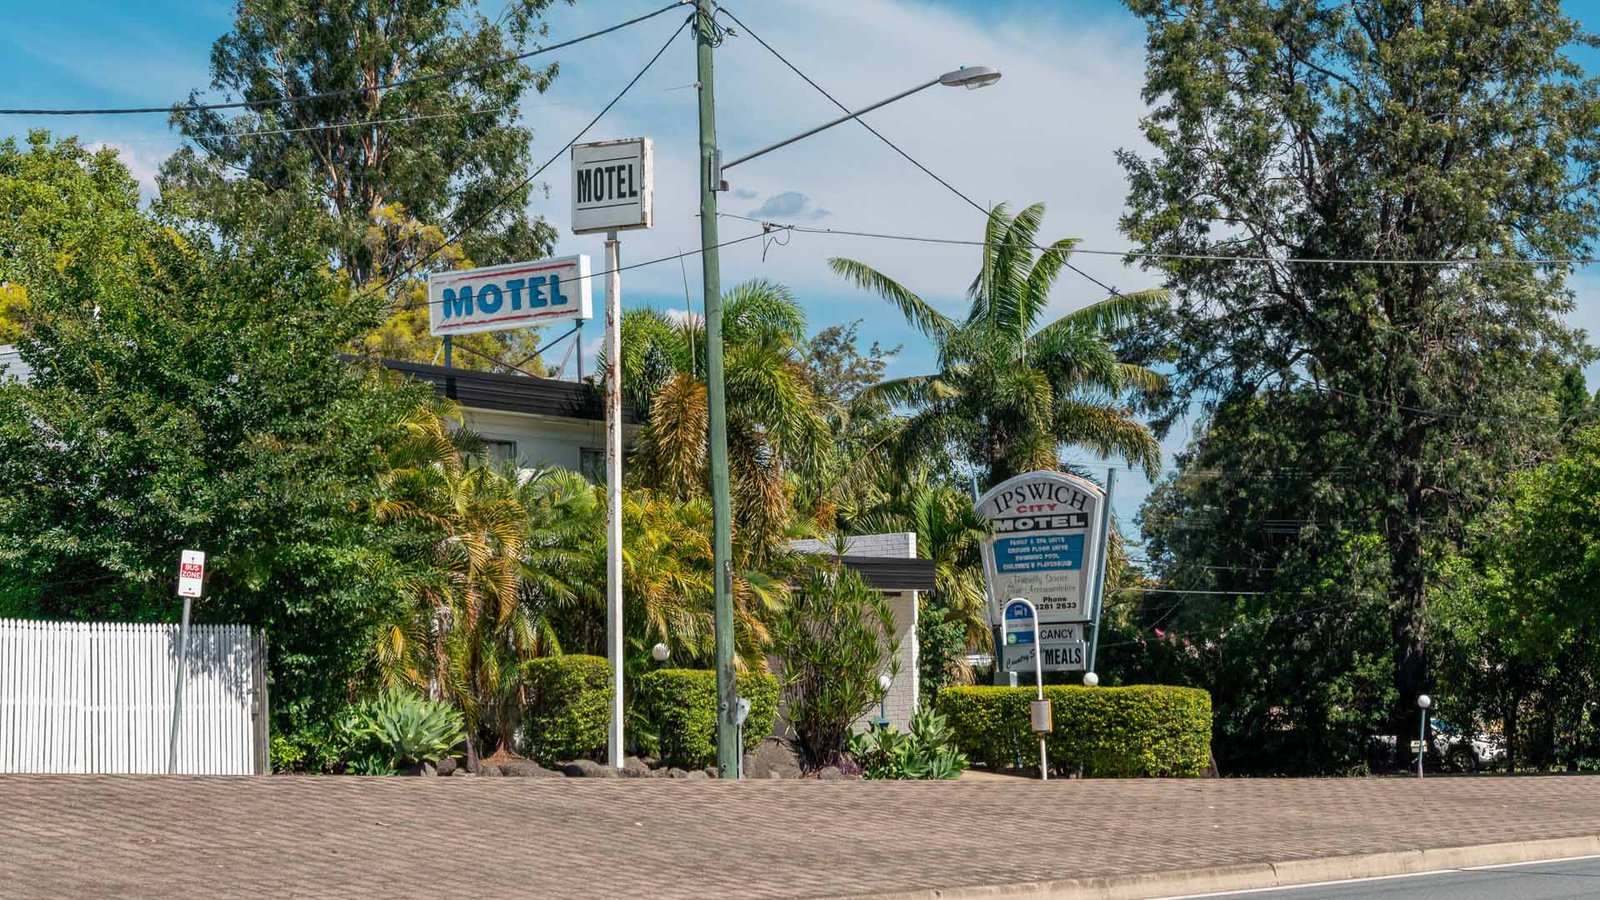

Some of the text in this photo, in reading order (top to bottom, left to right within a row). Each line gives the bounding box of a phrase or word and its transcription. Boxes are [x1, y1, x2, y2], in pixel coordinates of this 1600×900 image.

[577, 164, 638, 204] MOTEL
[442, 274, 568, 319] MOTEL
[992, 482, 1088, 514] IPSWICH
[1016, 503, 1058, 513] CITY
[992, 515, 1085, 532] MOTEL
[182, 570, 201, 578] ZONE
[1039, 628, 1074, 640] CANCY
[1045, 647, 1082, 665] MEALS
